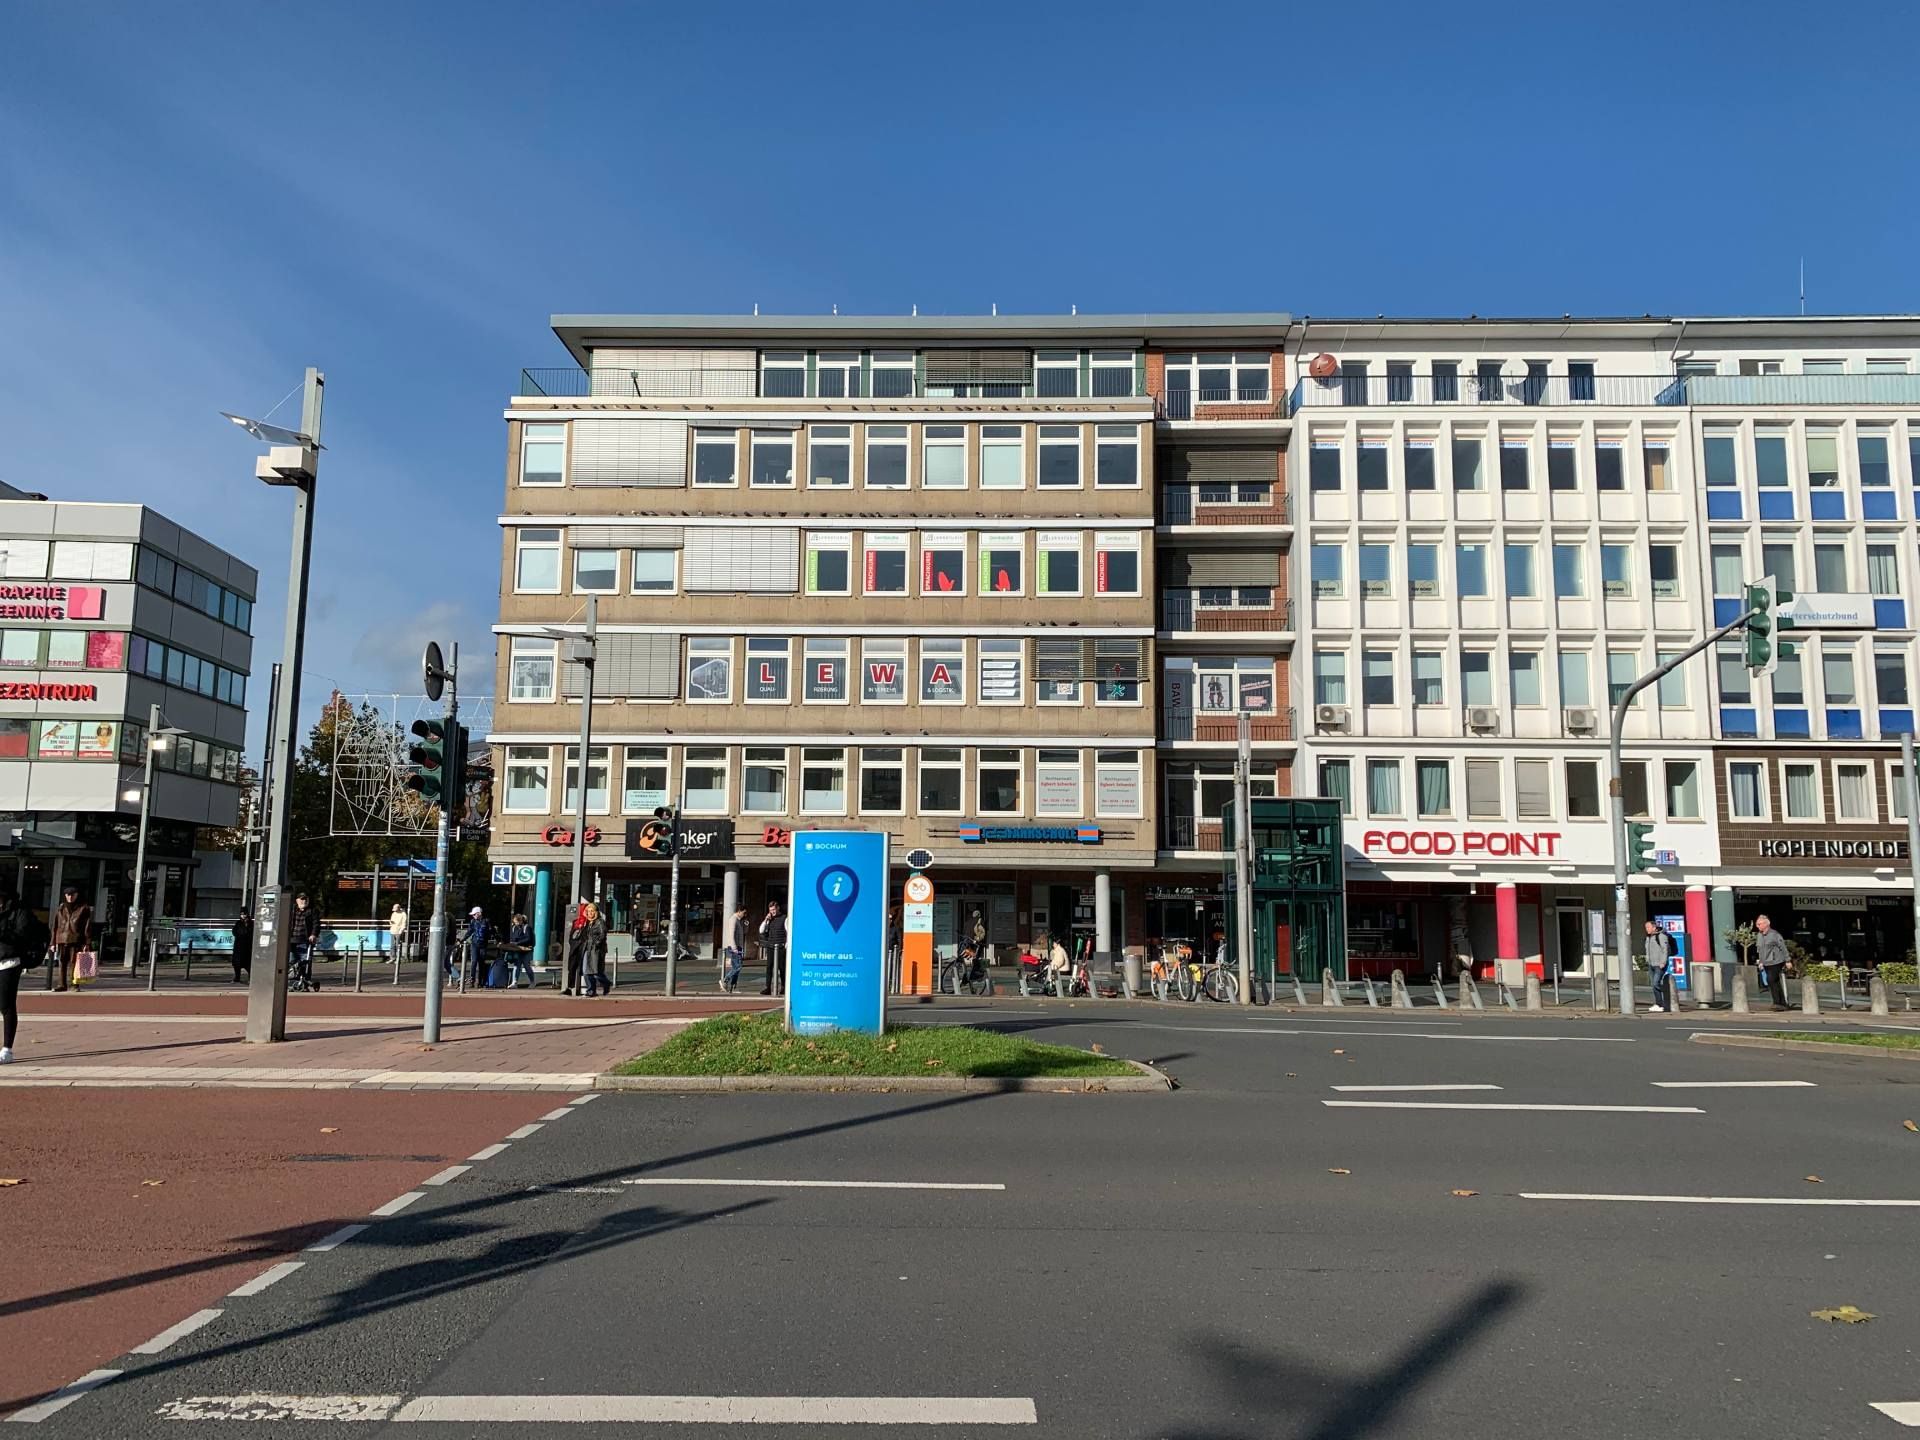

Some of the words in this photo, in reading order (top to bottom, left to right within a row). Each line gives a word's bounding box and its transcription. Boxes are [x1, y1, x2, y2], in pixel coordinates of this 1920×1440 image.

[0, 586, 61, 598] RAPHIE
[760, 663, 775, 684] L
[818, 663, 834, 684] E
[870, 664, 897, 684] W
[930, 664, 952, 684] A
[541, 825, 598, 845] Caé
[761, 825, 791, 845] Bä
[1364, 831, 1456, 855] FOOD
[1464, 832, 1561, 856] POINT
[1759, 840, 1909, 858] HOPFENDOLDE
[1794, 897, 1864, 906] HOPFENDOLDE
[823, 971, 858, 979] geradeaus
